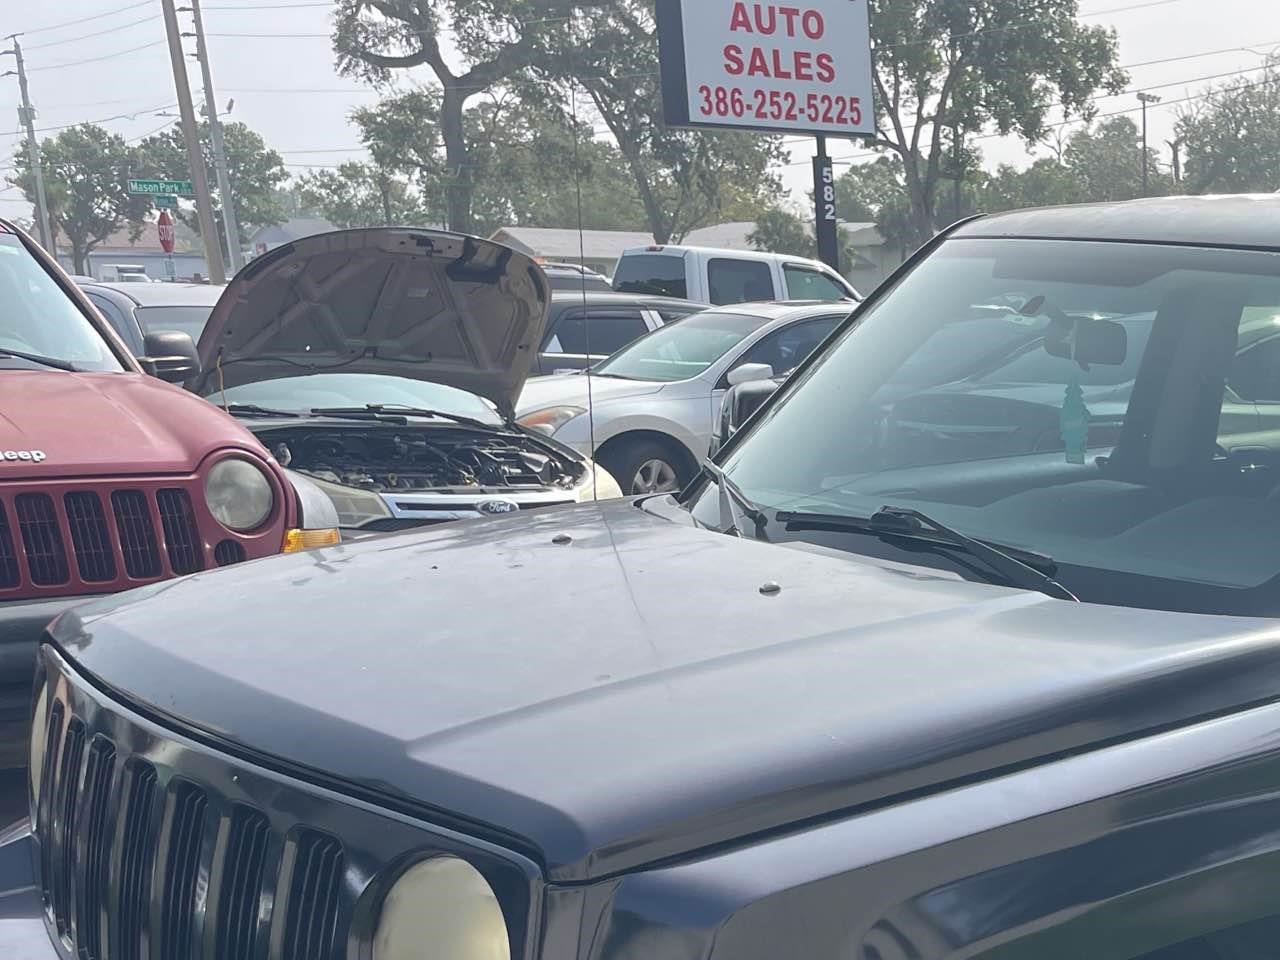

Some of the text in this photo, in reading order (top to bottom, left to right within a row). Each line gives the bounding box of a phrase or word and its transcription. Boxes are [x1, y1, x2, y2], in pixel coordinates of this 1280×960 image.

[730, 2, 824, 40] AUTO
[723, 45, 835, 83] SALES
[699, 85, 862, 125] 386-252-5225
[131, 182, 158, 193] Mason
[160, 182, 179, 193] Park
[489, 501, 511, 513] Ford
